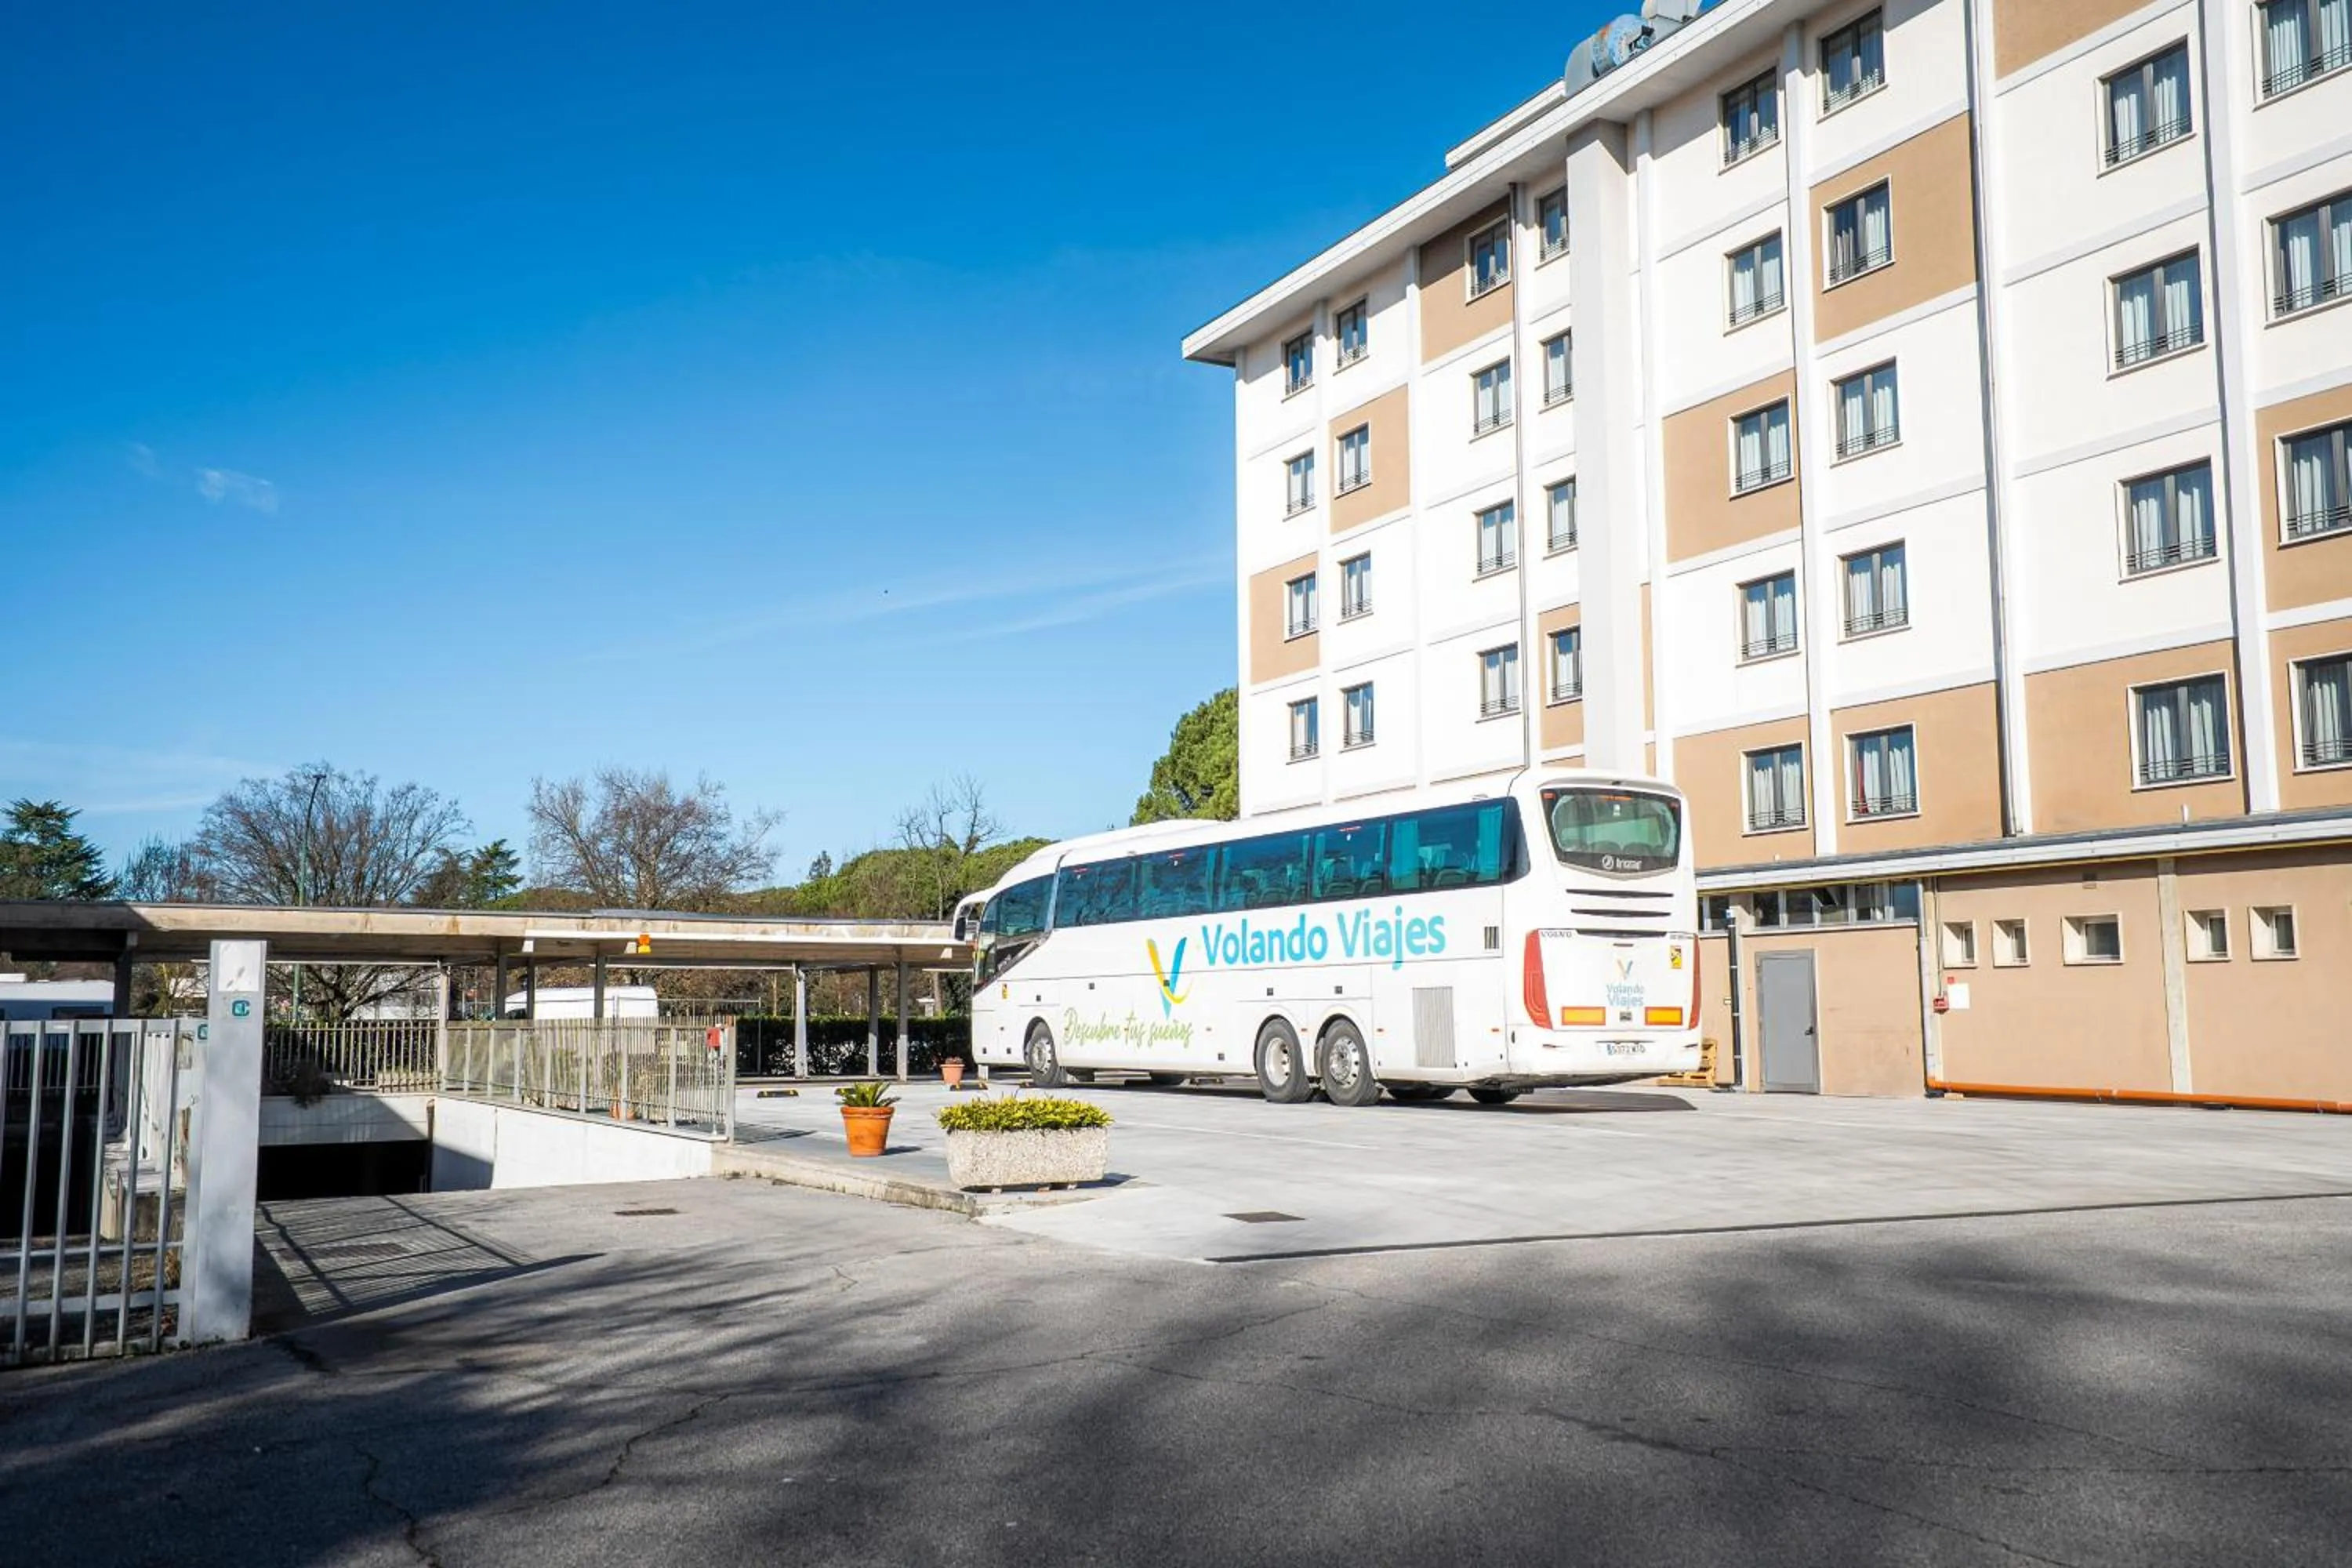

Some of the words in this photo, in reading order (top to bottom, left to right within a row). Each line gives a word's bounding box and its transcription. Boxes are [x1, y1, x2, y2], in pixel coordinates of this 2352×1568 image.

[1202, 913, 1328, 965] Volando
[1337, 906, 1446, 971] Viajes
[1606, 994, 1644, 1009] Viajes
[1063, 1007, 1121, 1046] Descubre
[1124, 1008, 1145, 1048] tus
